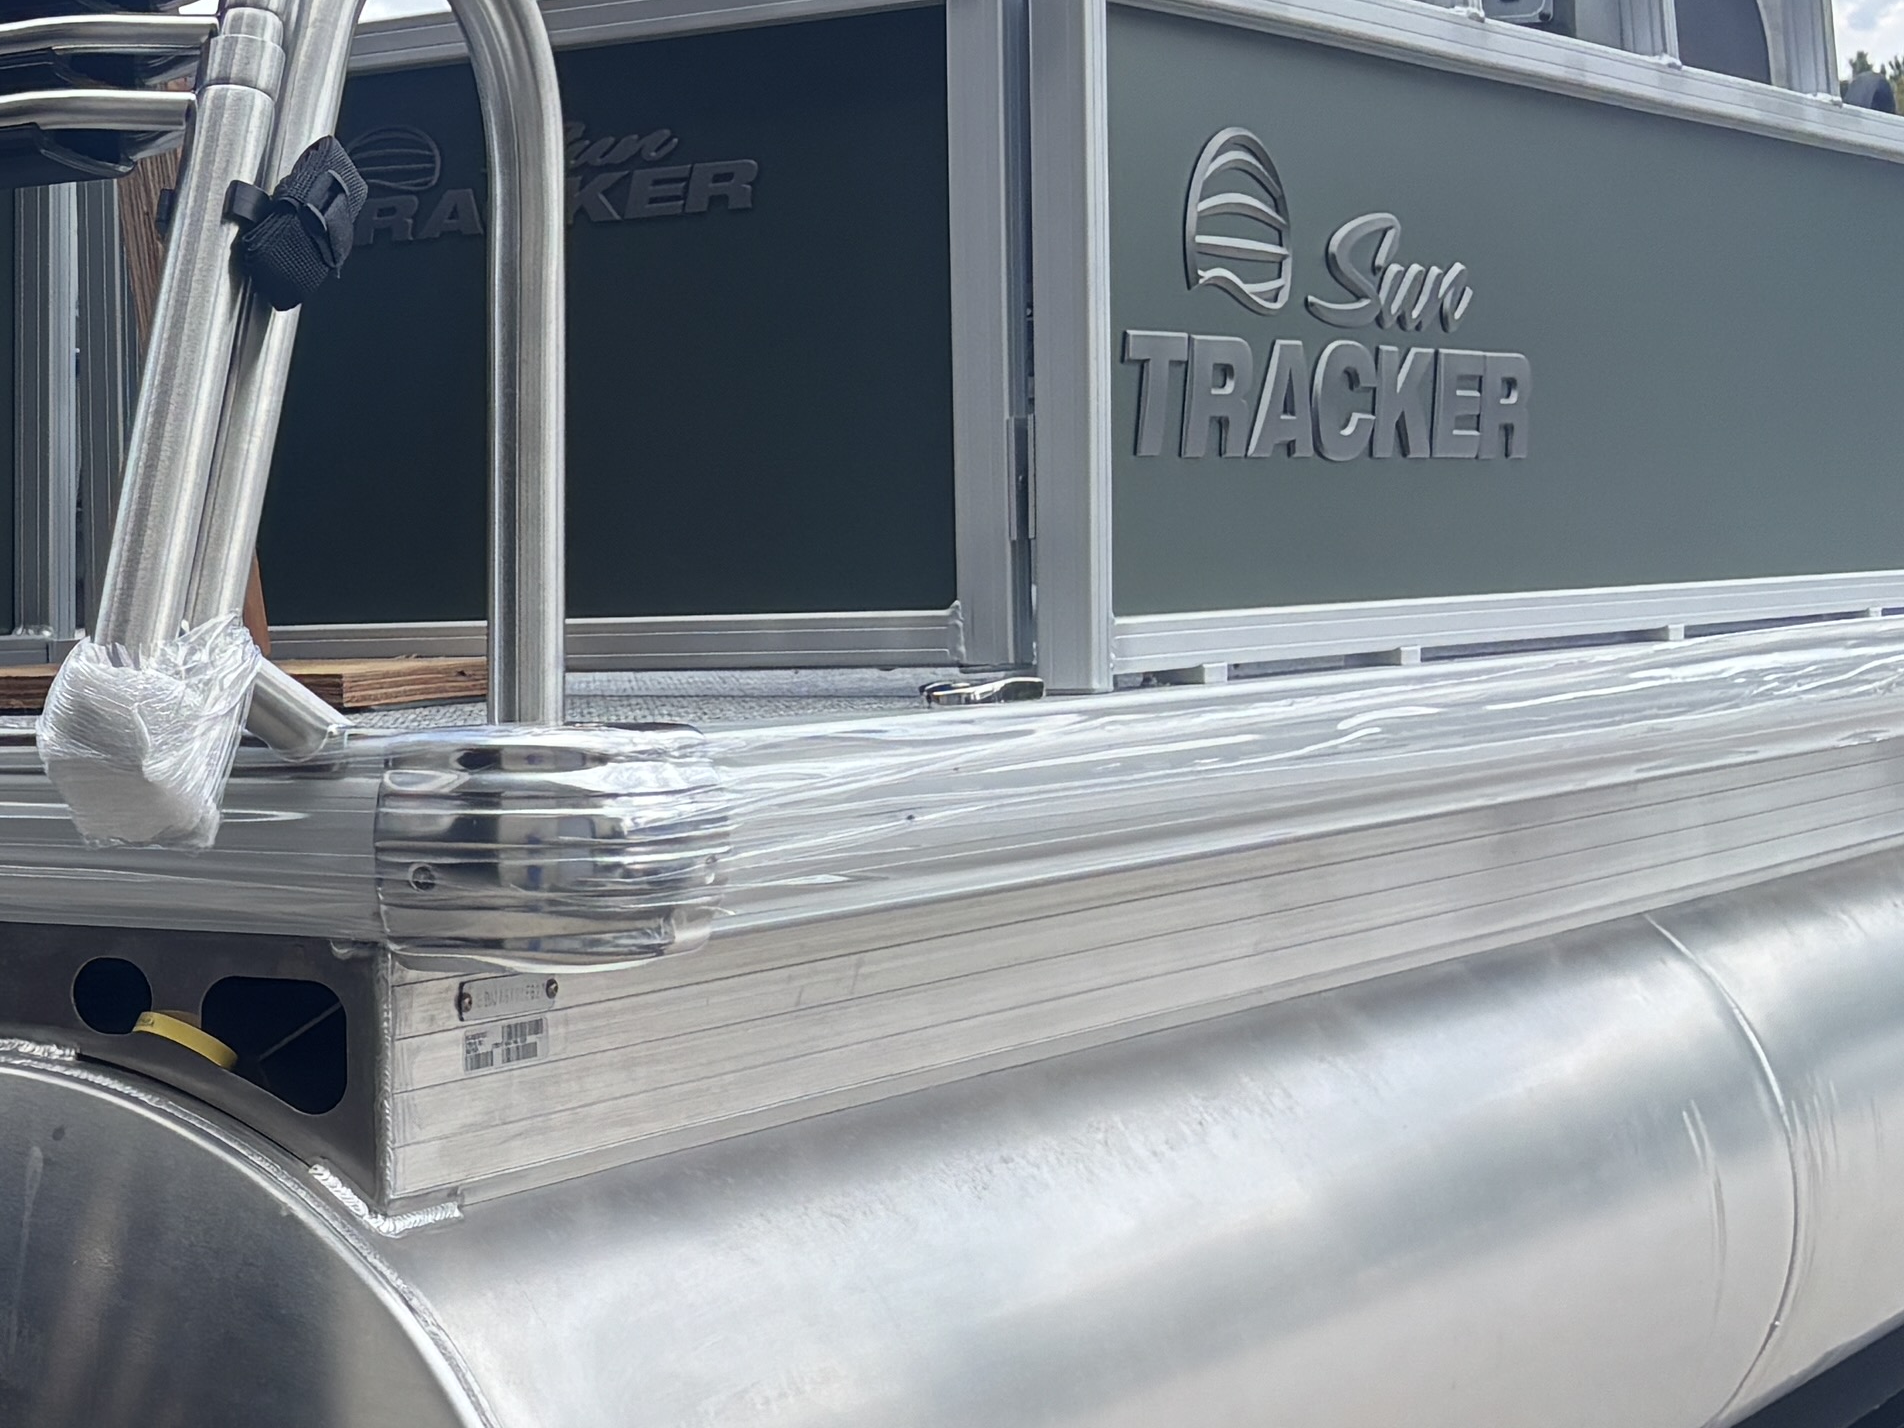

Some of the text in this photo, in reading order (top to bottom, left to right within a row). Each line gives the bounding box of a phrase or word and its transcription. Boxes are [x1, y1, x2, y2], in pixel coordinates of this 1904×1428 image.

[354, 159, 759, 247] RAKER
[1305, 212, 1474, 334] Sun
[1122, 329, 1533, 463] TRACKER
